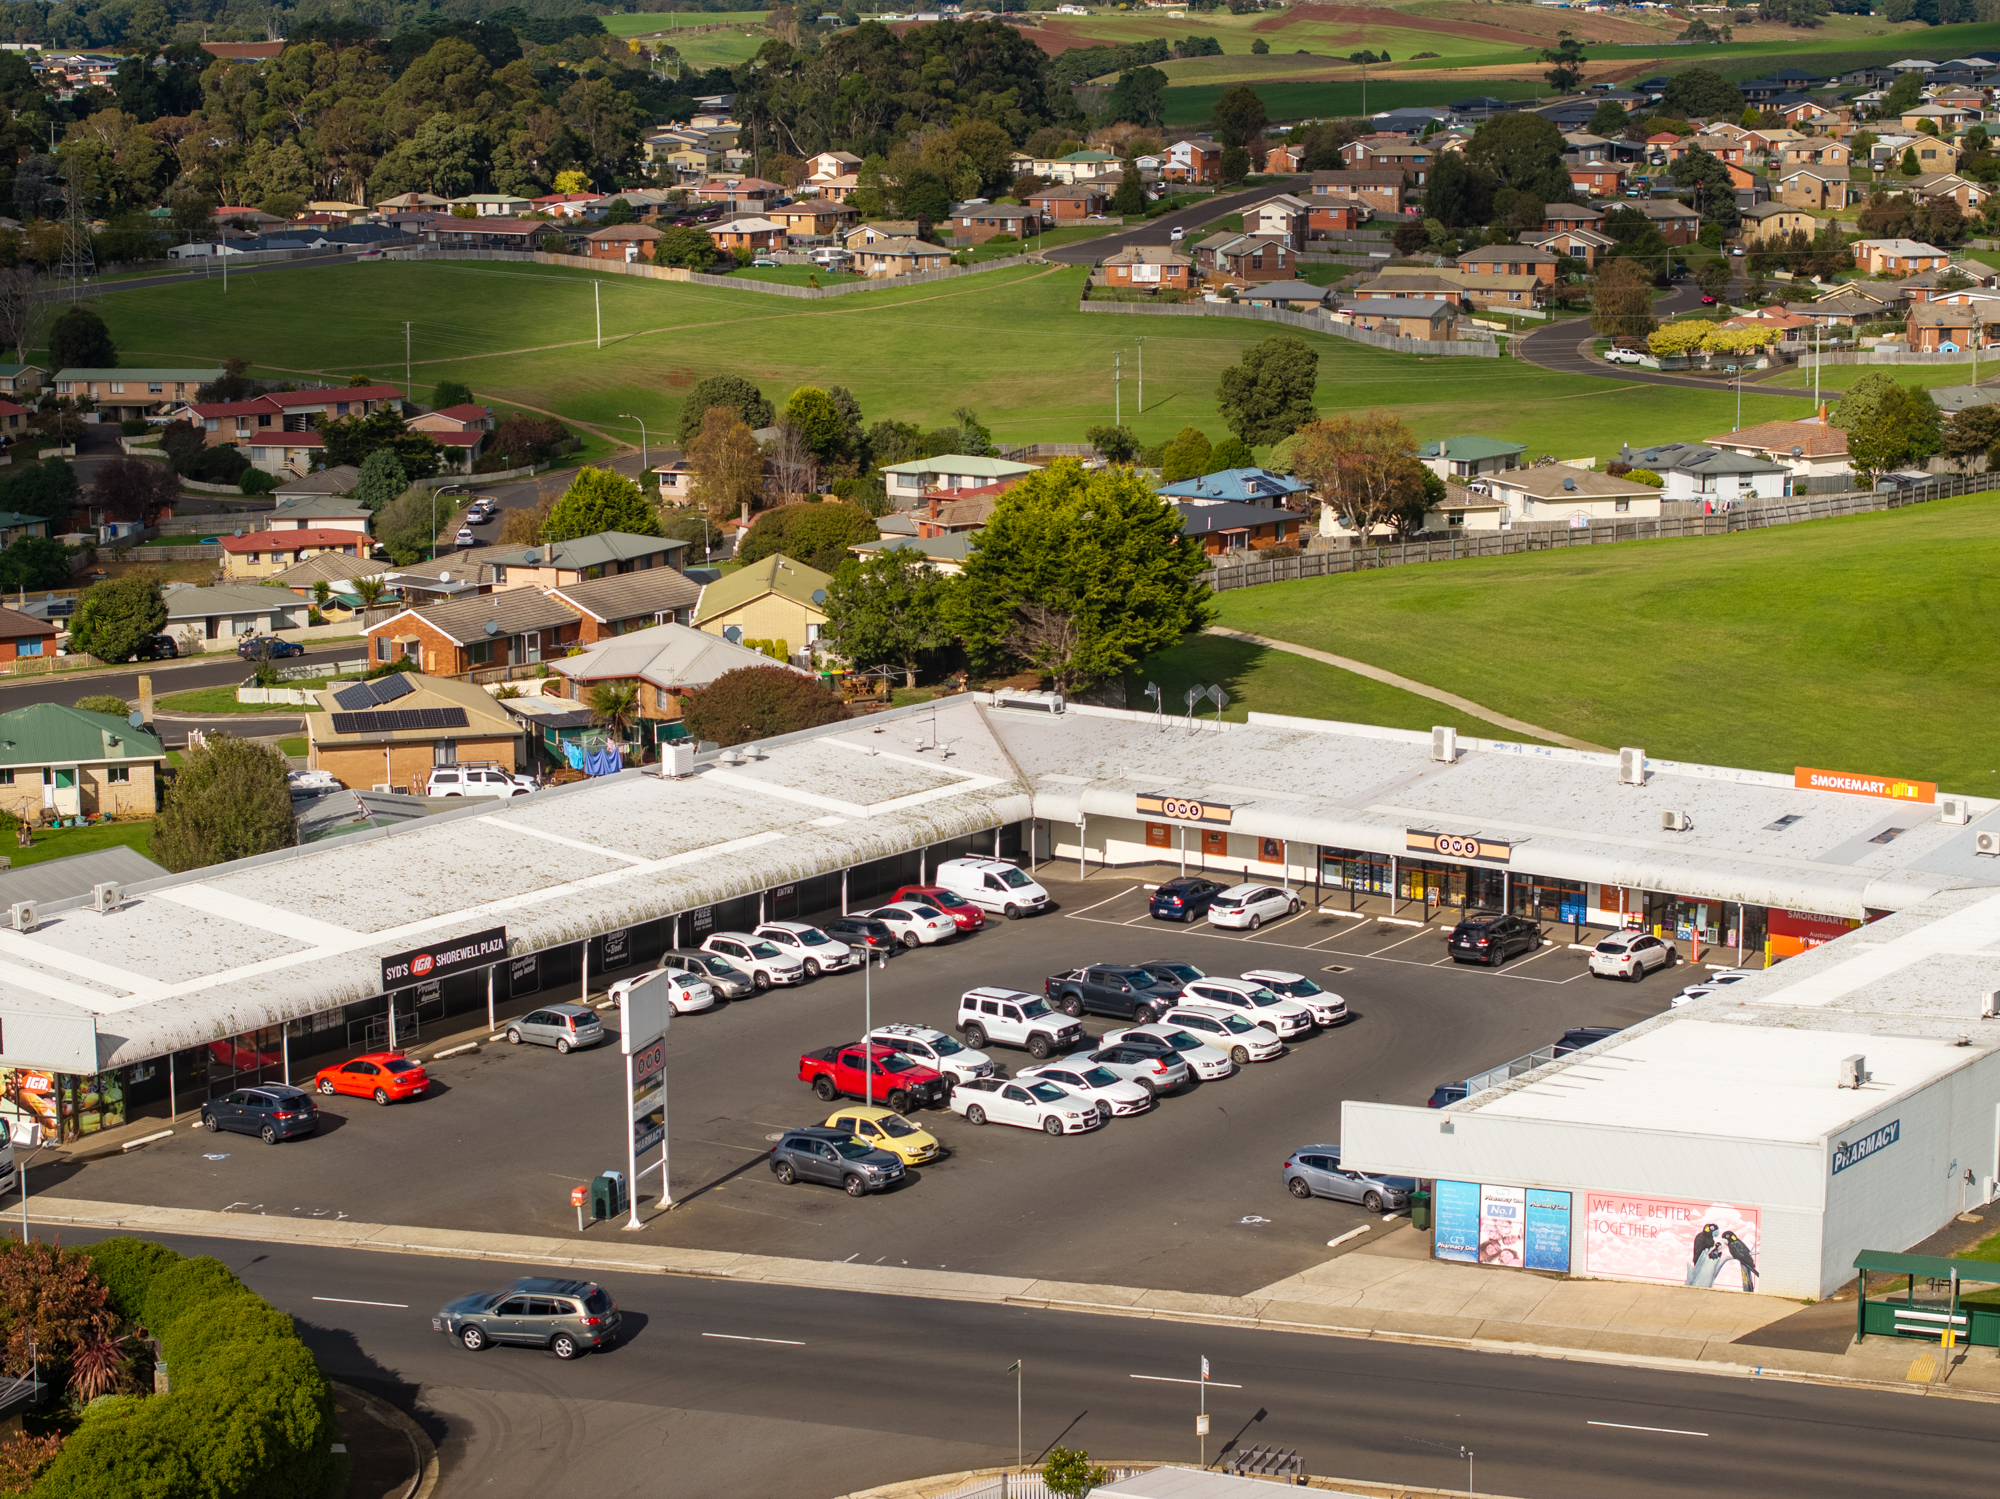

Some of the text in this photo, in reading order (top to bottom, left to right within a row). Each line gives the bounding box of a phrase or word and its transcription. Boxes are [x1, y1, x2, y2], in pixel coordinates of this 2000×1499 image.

[1810, 774, 1885, 794] SMOKEMART
[1167, 802, 1198, 816] BWS
[1441, 840, 1473, 853] BWS
[776, 885, 795, 898] ENTRY
[693, 906, 712, 920] FREE
[1787, 910, 1844, 926] SMOKEMART
[386, 938, 504, 981] SYD'S IGA SHOREWELL PLAZA
[25, 1076, 48, 1091] IGA
[1834, 1122, 1898, 1172] PHARMACY
[1593, 1199, 1691, 1221] WE ARE BETTER
[1593, 1219, 1658, 1239] TOGETHER
[1437, 1242, 1464, 1252] Pharmacy
